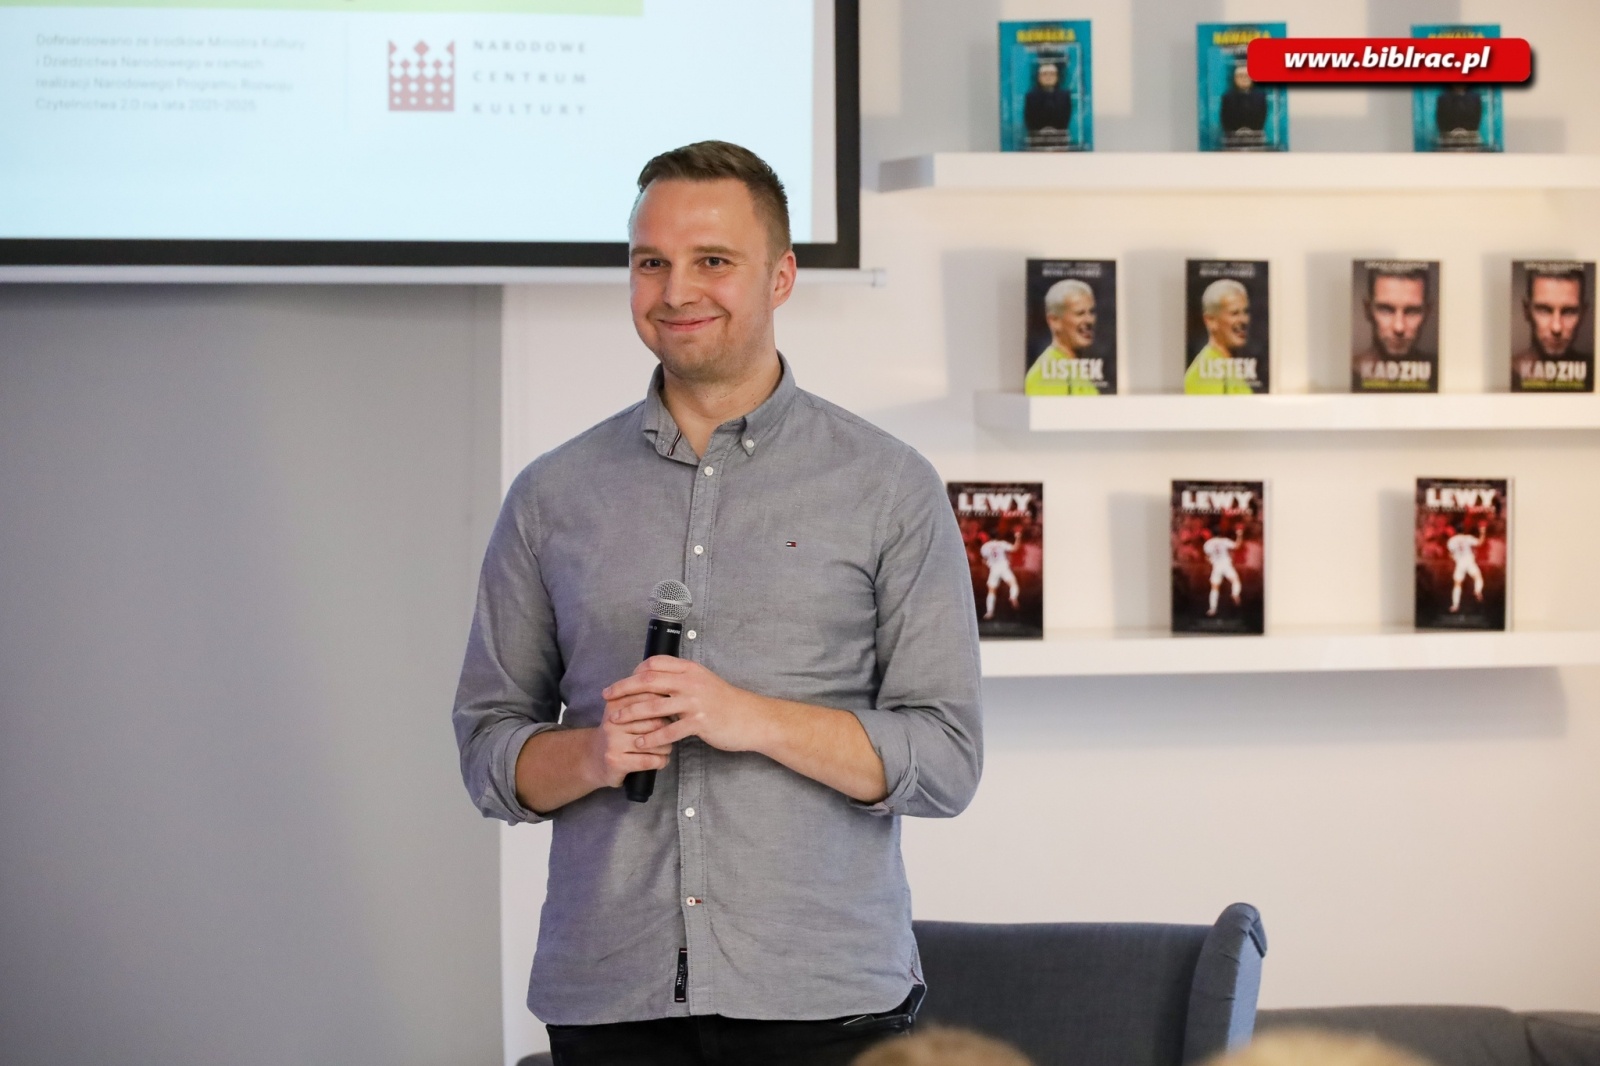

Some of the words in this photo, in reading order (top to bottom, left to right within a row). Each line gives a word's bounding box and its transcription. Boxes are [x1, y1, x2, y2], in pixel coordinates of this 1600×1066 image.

[473, 40, 586, 54] NARODOWE
[472, 71, 586, 85] CENTRUM
[472, 103, 586, 116] KULTURY
[1041, 358, 1104, 380] LISTEK
[1200, 357, 1258, 380] LISTEK
[1360, 360, 1431, 380] KADZIU
[1521, 360, 1587, 380] KADZIU
[958, 492, 1032, 512] LEWY
[1181, 490, 1254, 510] LEWY
[1426, 487, 1497, 508] LEWY
